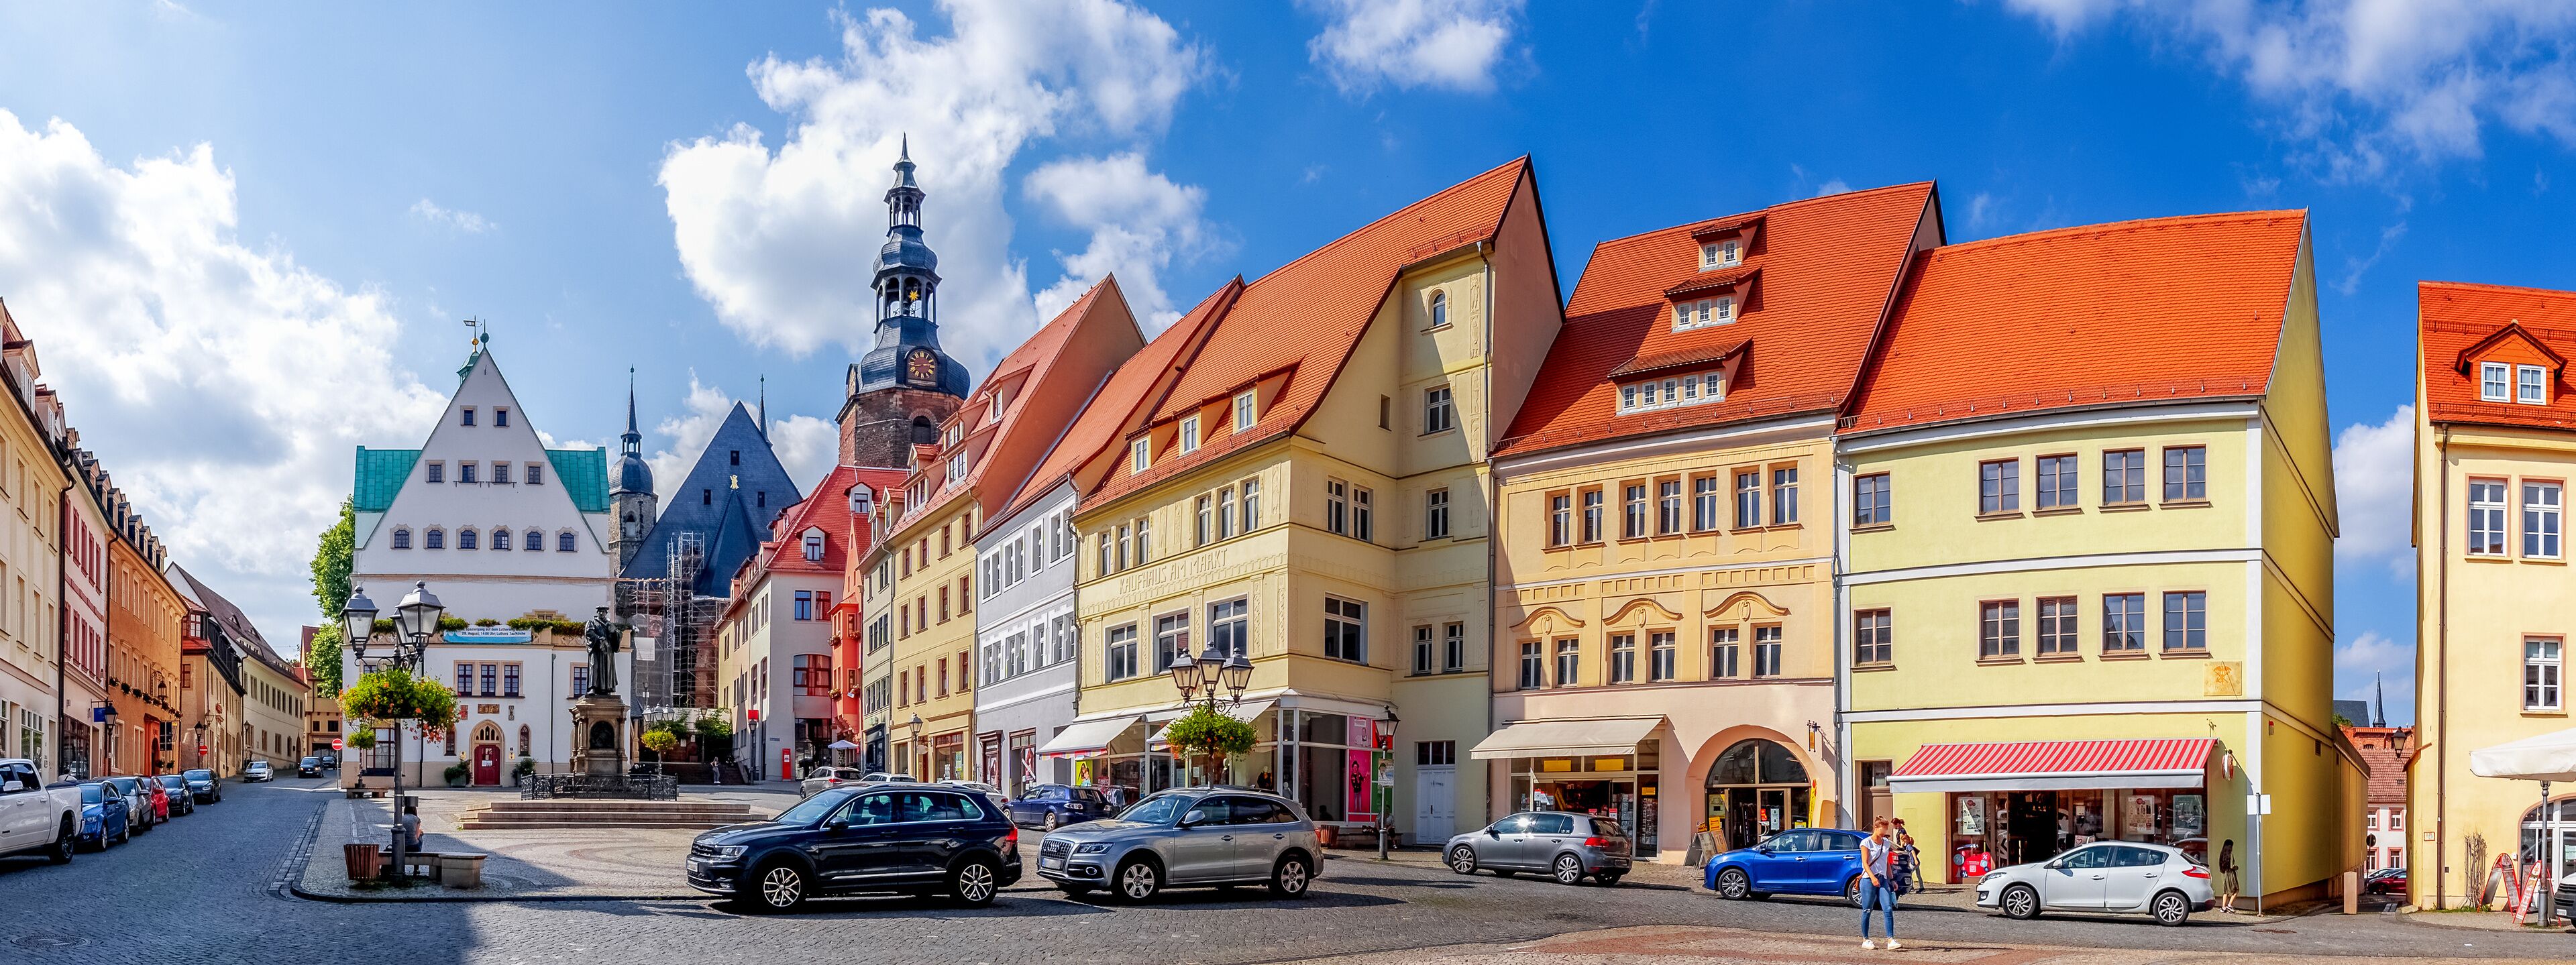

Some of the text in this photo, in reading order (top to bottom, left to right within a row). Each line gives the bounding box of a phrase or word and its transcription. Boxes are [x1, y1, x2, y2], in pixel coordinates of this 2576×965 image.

[1120, 549, 1228, 594] KAUFHAUS AM MARKT
